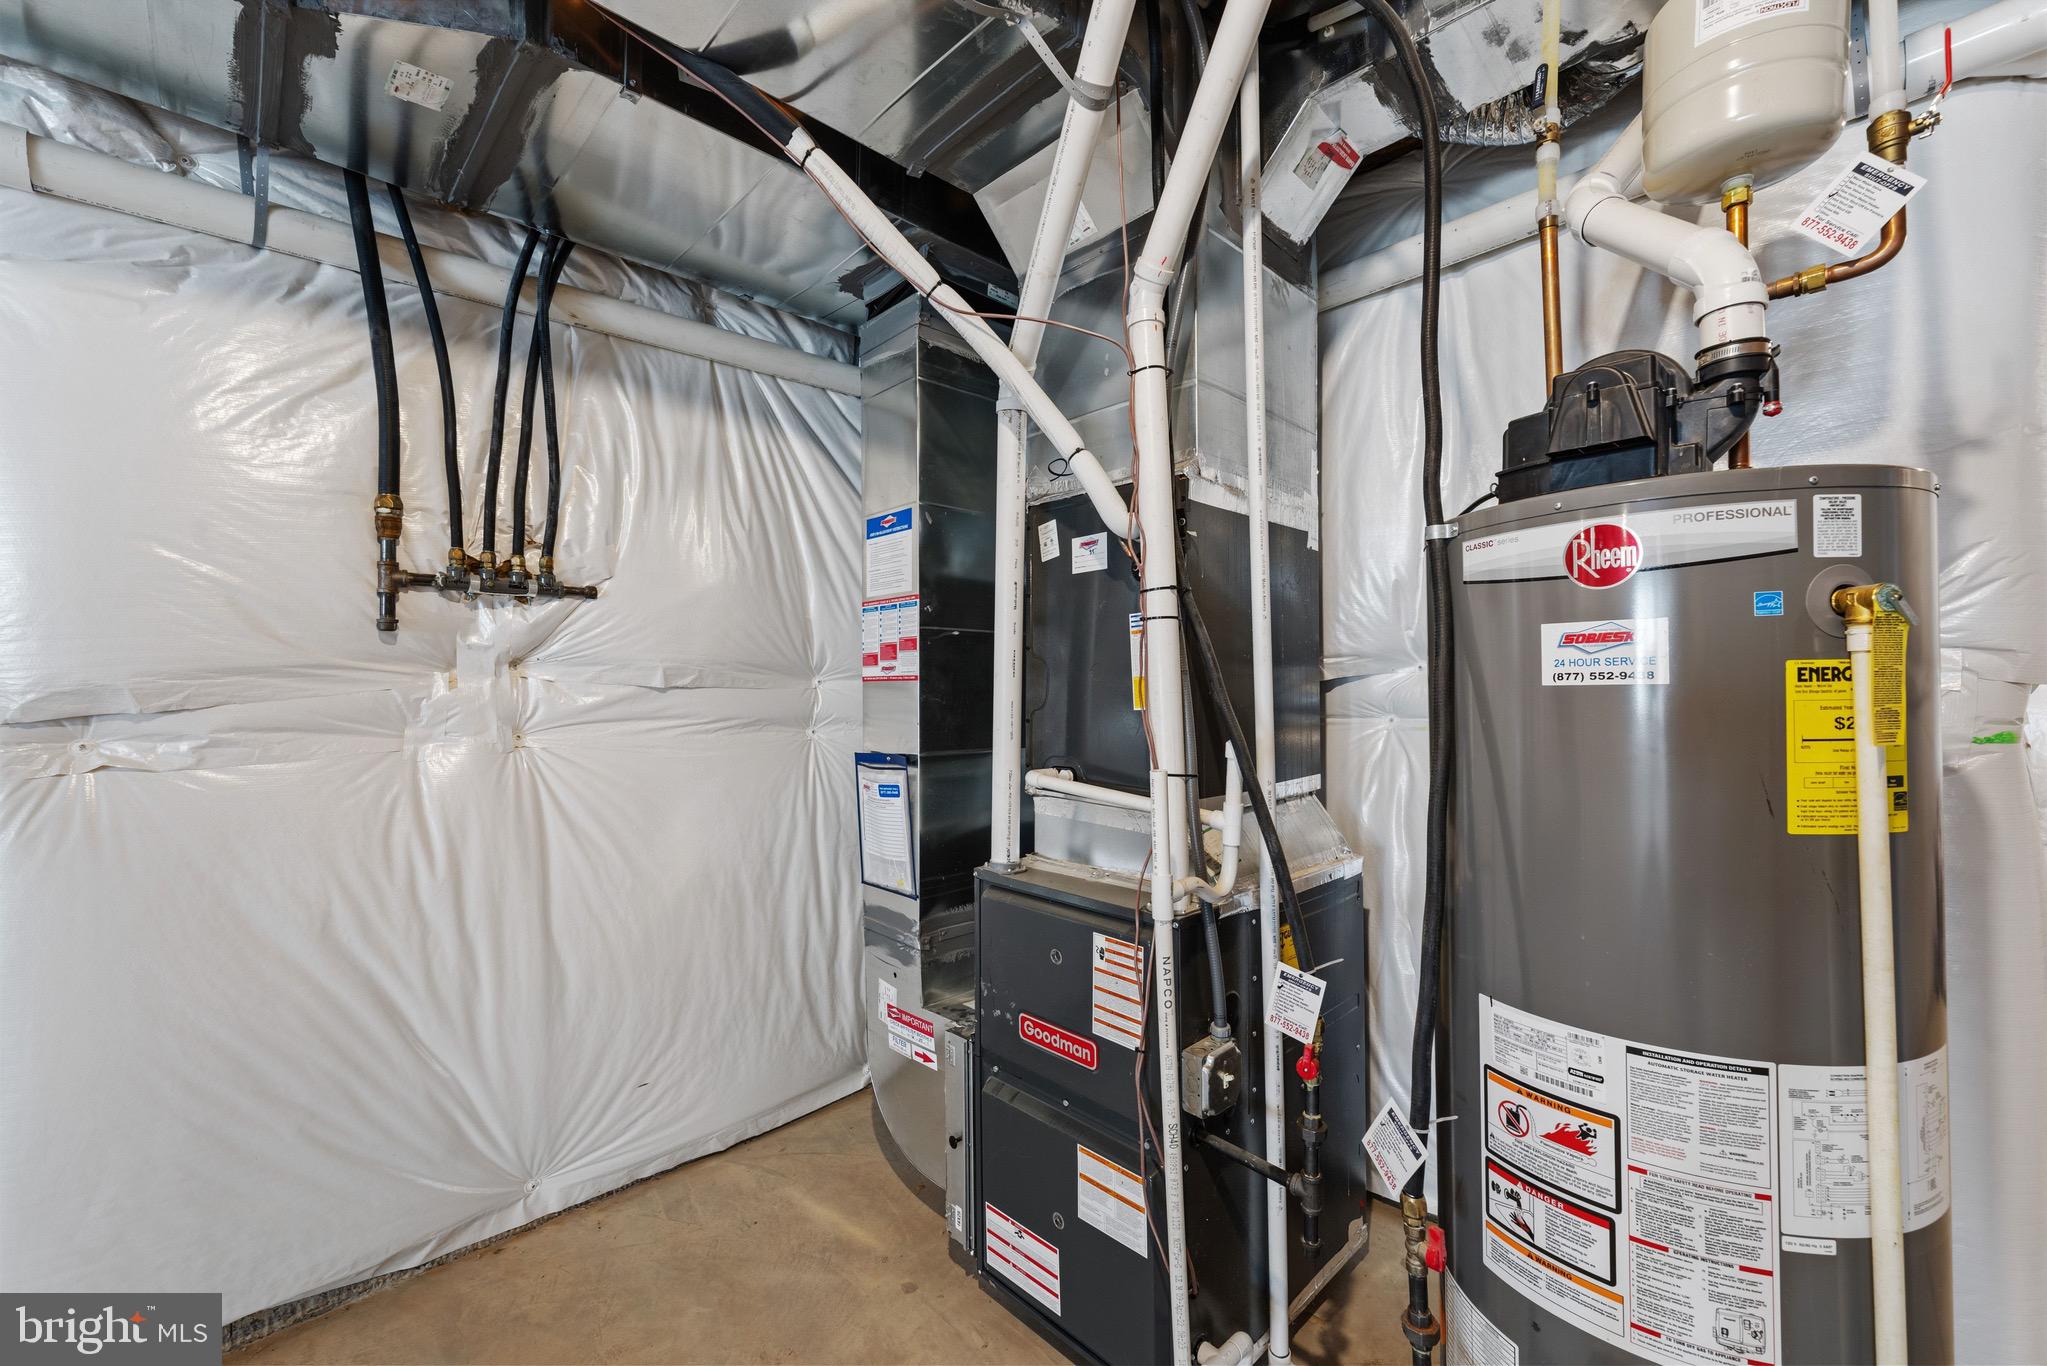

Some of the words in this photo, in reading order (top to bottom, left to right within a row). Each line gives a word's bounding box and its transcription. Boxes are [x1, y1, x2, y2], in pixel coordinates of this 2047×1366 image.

[1861, 164, 1912, 190] EMERGENCY
[1801, 217, 1859, 250] 877-552-9438
[1825, 219, 1846, 232] Service
[1673, 506, 1791, 524] PROFESSIONAL
[1466, 540, 1493, 552] CLASSIC
[1497, 537, 1518, 546] series
[1572, 526, 1637, 578] Rheem
[1563, 631, 1634, 644] SOBIESK
[1554, 659, 1565, 667] 24
[1569, 658, 1601, 667] HOUR
[1553, 672, 1584, 682] (877)
[1797, 666, 1852, 682] ENERG
[1835, 716, 1854, 730] $2
[901, 1013, 934, 1033] IMPORTANT
[1023, 1019, 1092, 1062] Goodman
[1162, 956, 1173, 1009] NAPCO
[1168, 1123, 1179, 1149] SCH40
[1642, 1051, 1681, 1061] INSTALLATION
[1695, 1059, 1727, 1069] OPERATION
[1728, 1064, 1751, 1072] DETAILS
[1647, 1060, 1678, 1070] AUTOMATIC
[1679, 1066, 1704, 1075] STORAGE
[1726, 1073, 1747, 1081] HEATER
[1525, 1090, 1571, 1114] WARNING
[1525, 1186, 1564, 1210] DANGER
[1673, 1177, 1690, 1185] SAFETY
[1706, 1184, 1723, 1192] BEFORE
[1725, 1187, 1751, 1198] OPERATING
[1535, 1253, 1572, 1281] WARNING
[1673, 1249, 1698, 1260] OPERATING
[1700, 1256, 1733, 1268] INSTRUCTIONS
[1673, 1338, 1685, 1346] TURN
[1714, 1351, 1740, 1362] APPLIANCE
